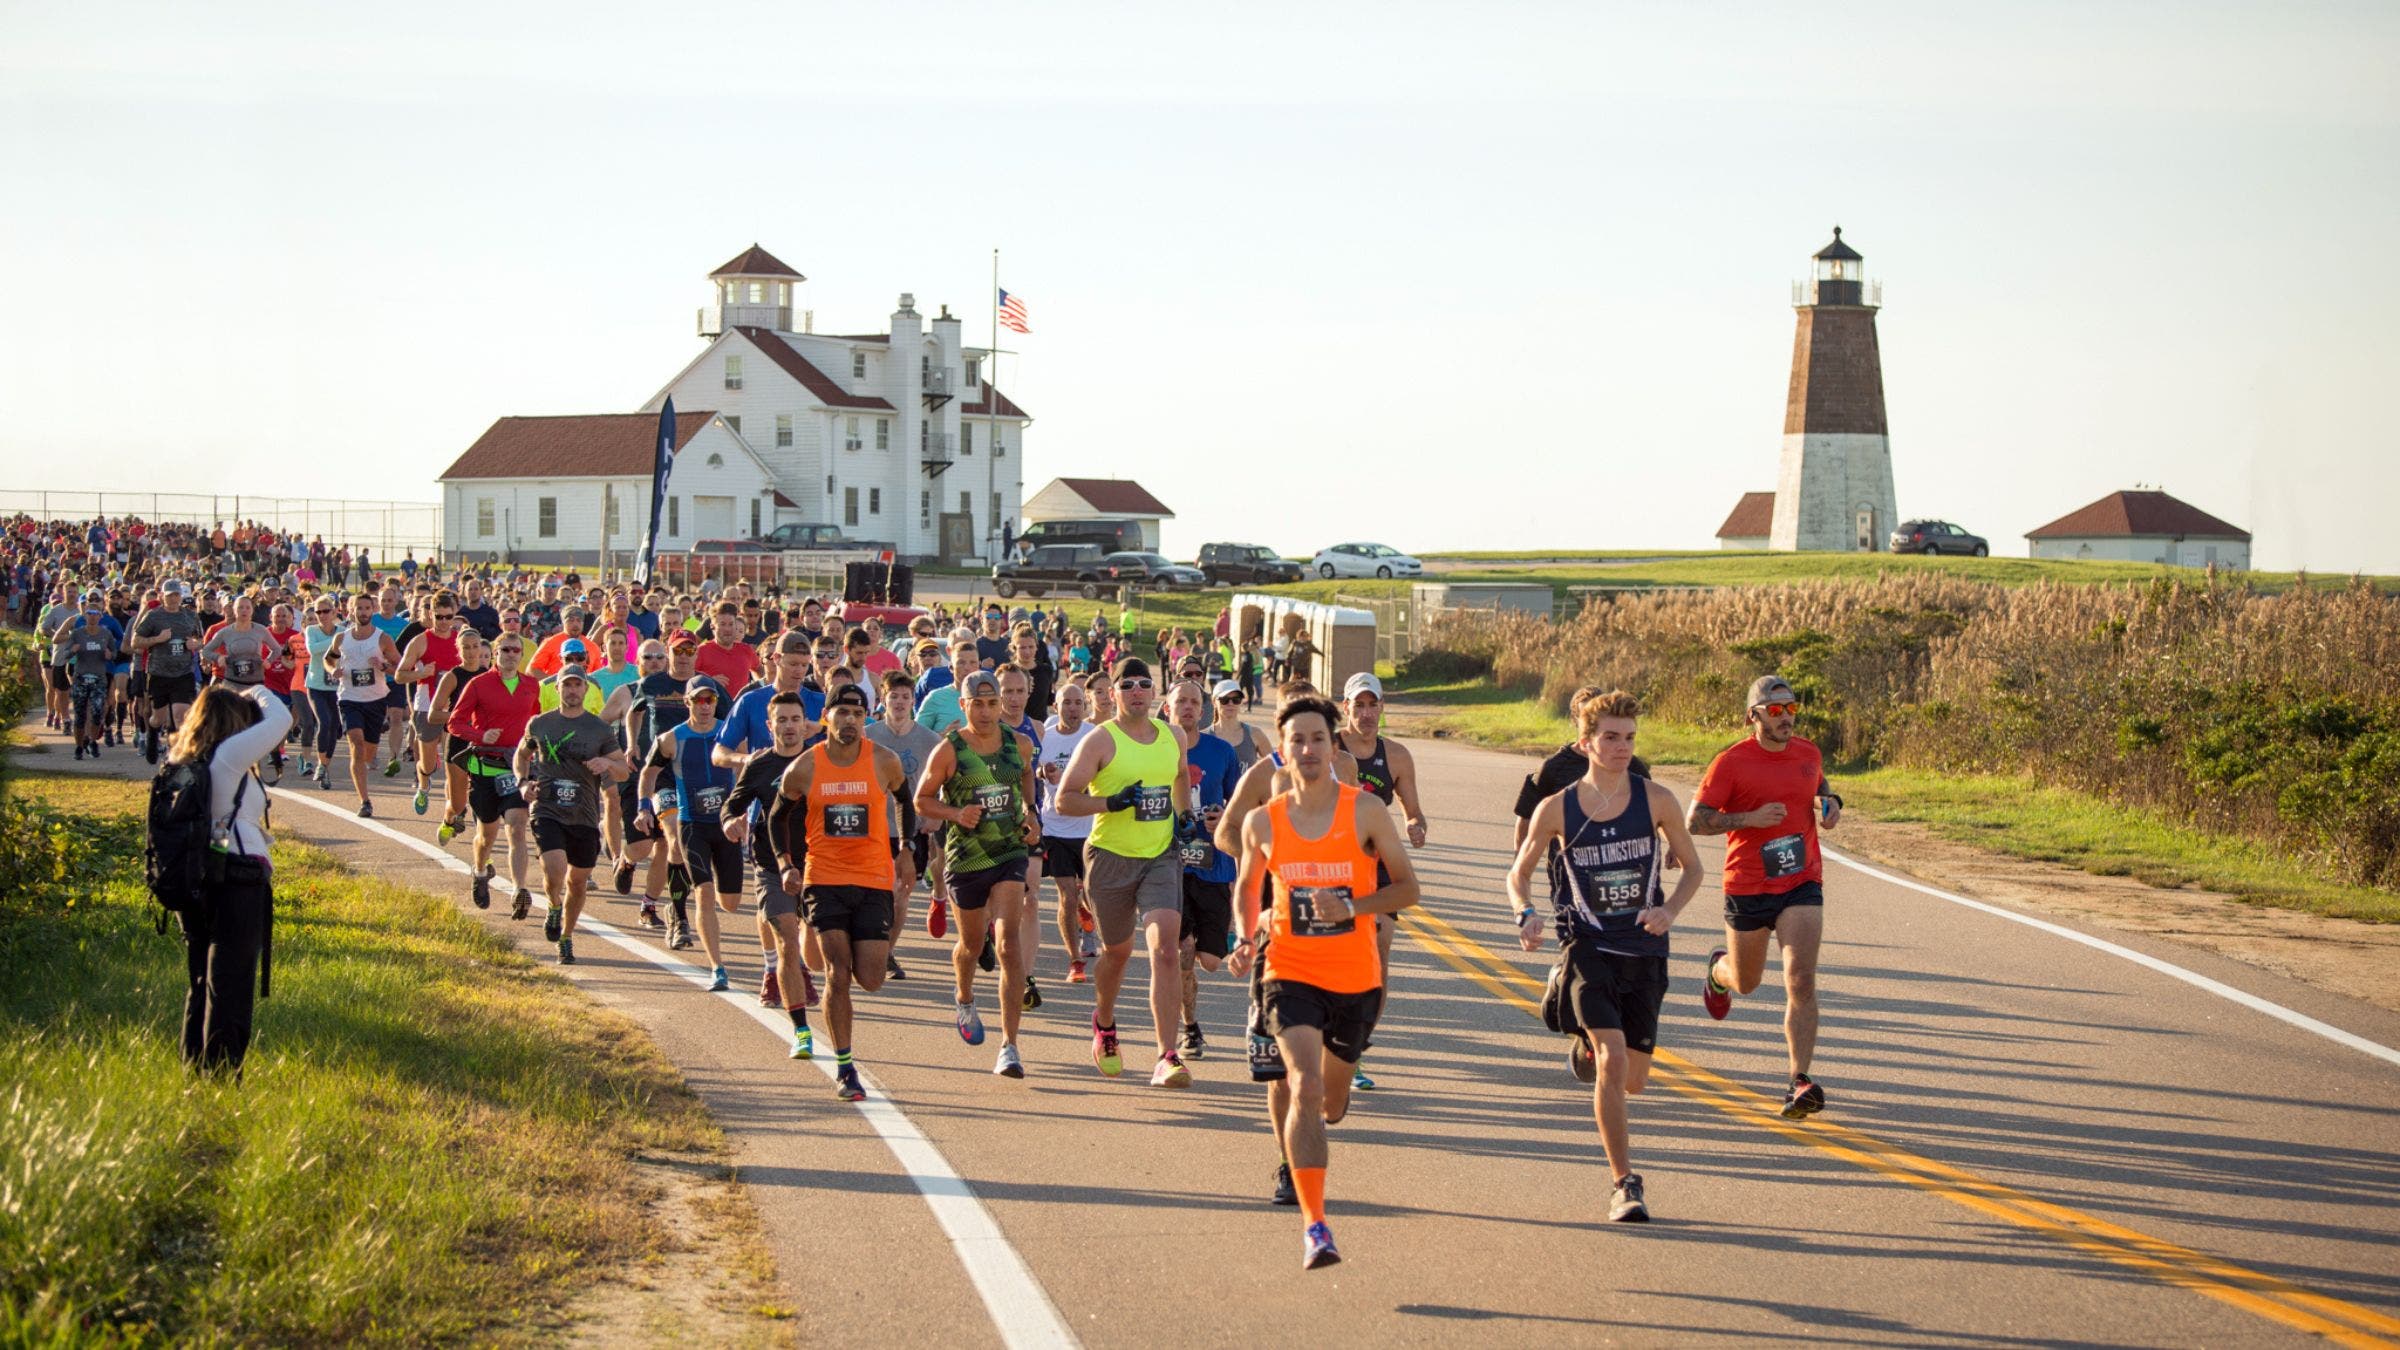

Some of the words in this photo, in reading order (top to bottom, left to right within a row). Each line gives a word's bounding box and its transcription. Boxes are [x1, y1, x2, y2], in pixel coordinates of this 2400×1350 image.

[557, 788, 576, 797] 665
[703, 795, 722, 807] 293
[980, 794, 1009, 808] 1807
[1141, 797, 1168, 810] 1927
[834, 815, 859, 827] 415
[1181, 849, 1204, 860] 929
[1572, 845, 1600, 867] SOUTH
[1601, 836, 1652, 864] KINGSTOWN
[1777, 849, 1795, 864] 34
[1599, 883, 1641, 902] 1558
[1249, 1040, 1279, 1057] 316
